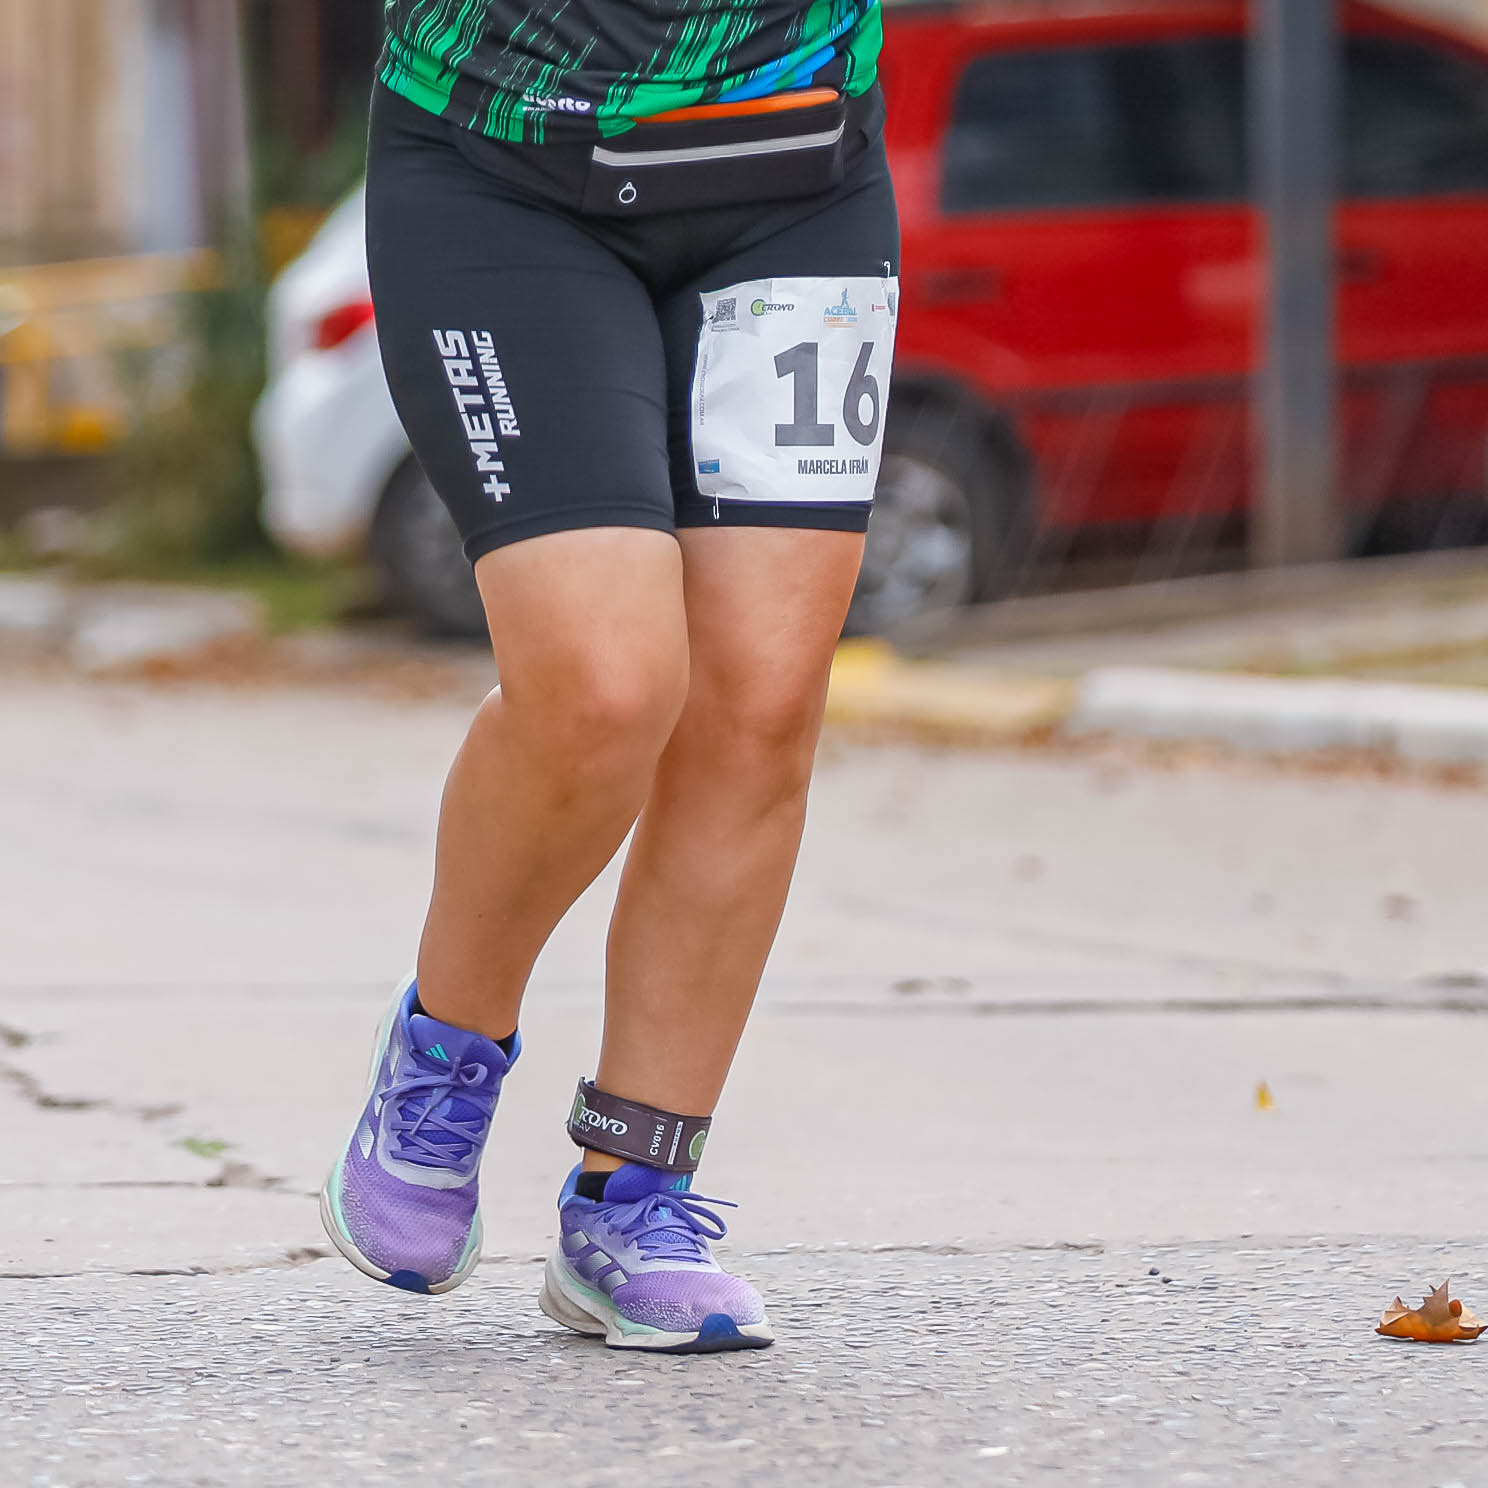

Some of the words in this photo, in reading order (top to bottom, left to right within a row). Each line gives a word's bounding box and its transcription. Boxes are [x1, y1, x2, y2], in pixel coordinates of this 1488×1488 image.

[471, 330, 521, 437] RUNNING
[774, 342, 880, 446] 16
[798, 459, 847, 474] MARCELA
[849, 456, 869, 474] IFRÁN
[649, 1123, 665, 1156] CV016
